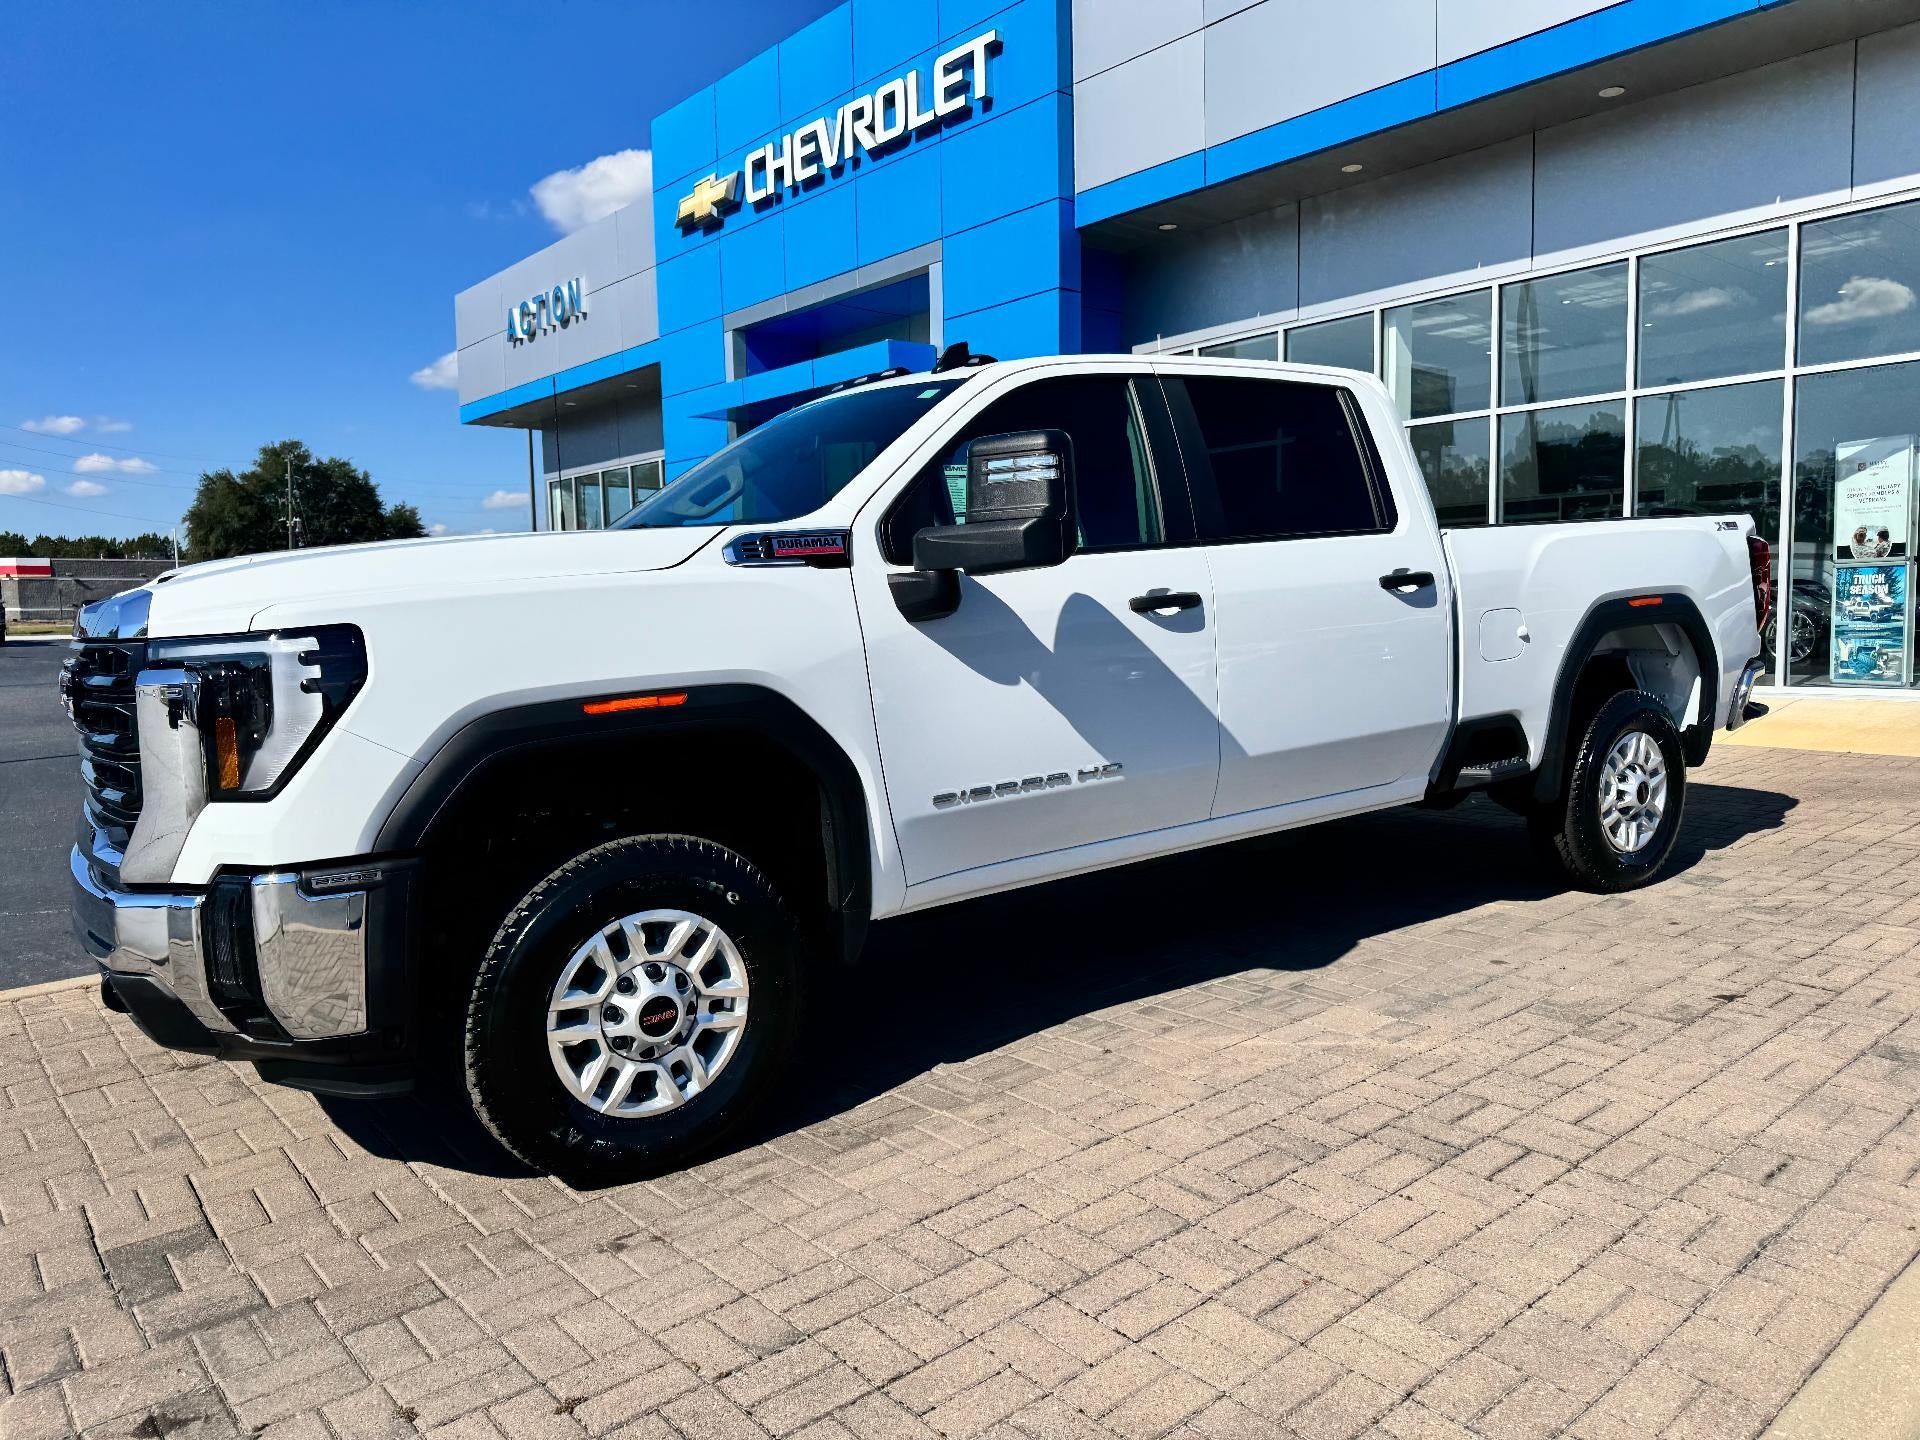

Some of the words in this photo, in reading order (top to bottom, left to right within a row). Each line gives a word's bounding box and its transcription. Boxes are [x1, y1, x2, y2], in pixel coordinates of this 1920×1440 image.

[744, 29, 999, 204] CHEVROLET
[507, 277, 583, 343] ACTION
[777, 537, 839, 549] DURAMAX
[1852, 573, 1886, 585] TRUCK
[1849, 583, 1889, 595] SEASON
